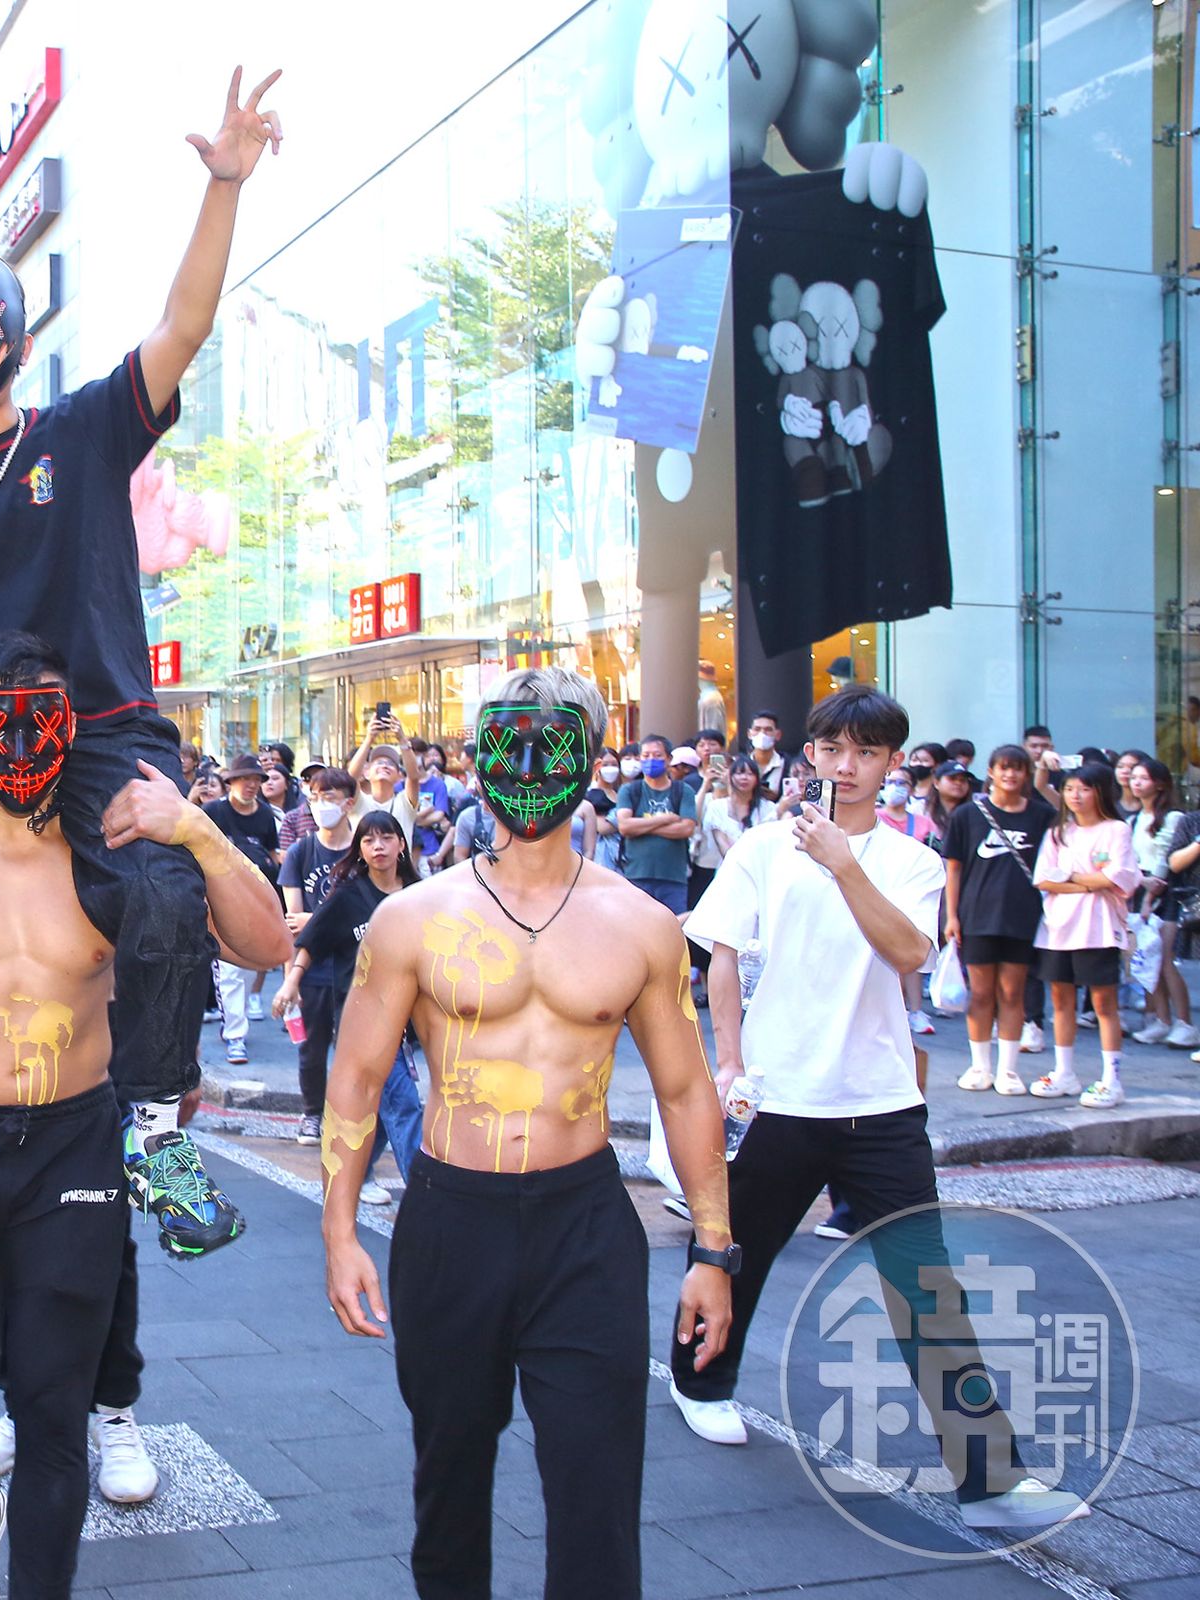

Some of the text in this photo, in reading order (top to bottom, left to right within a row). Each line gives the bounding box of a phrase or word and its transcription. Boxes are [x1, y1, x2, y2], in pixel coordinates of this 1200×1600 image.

[353, 591, 373, 614] ユニ
[383, 581, 405, 607] UNI
[383, 605, 407, 633] QLO
[60, 1189, 107, 1204] GYMSHARK
